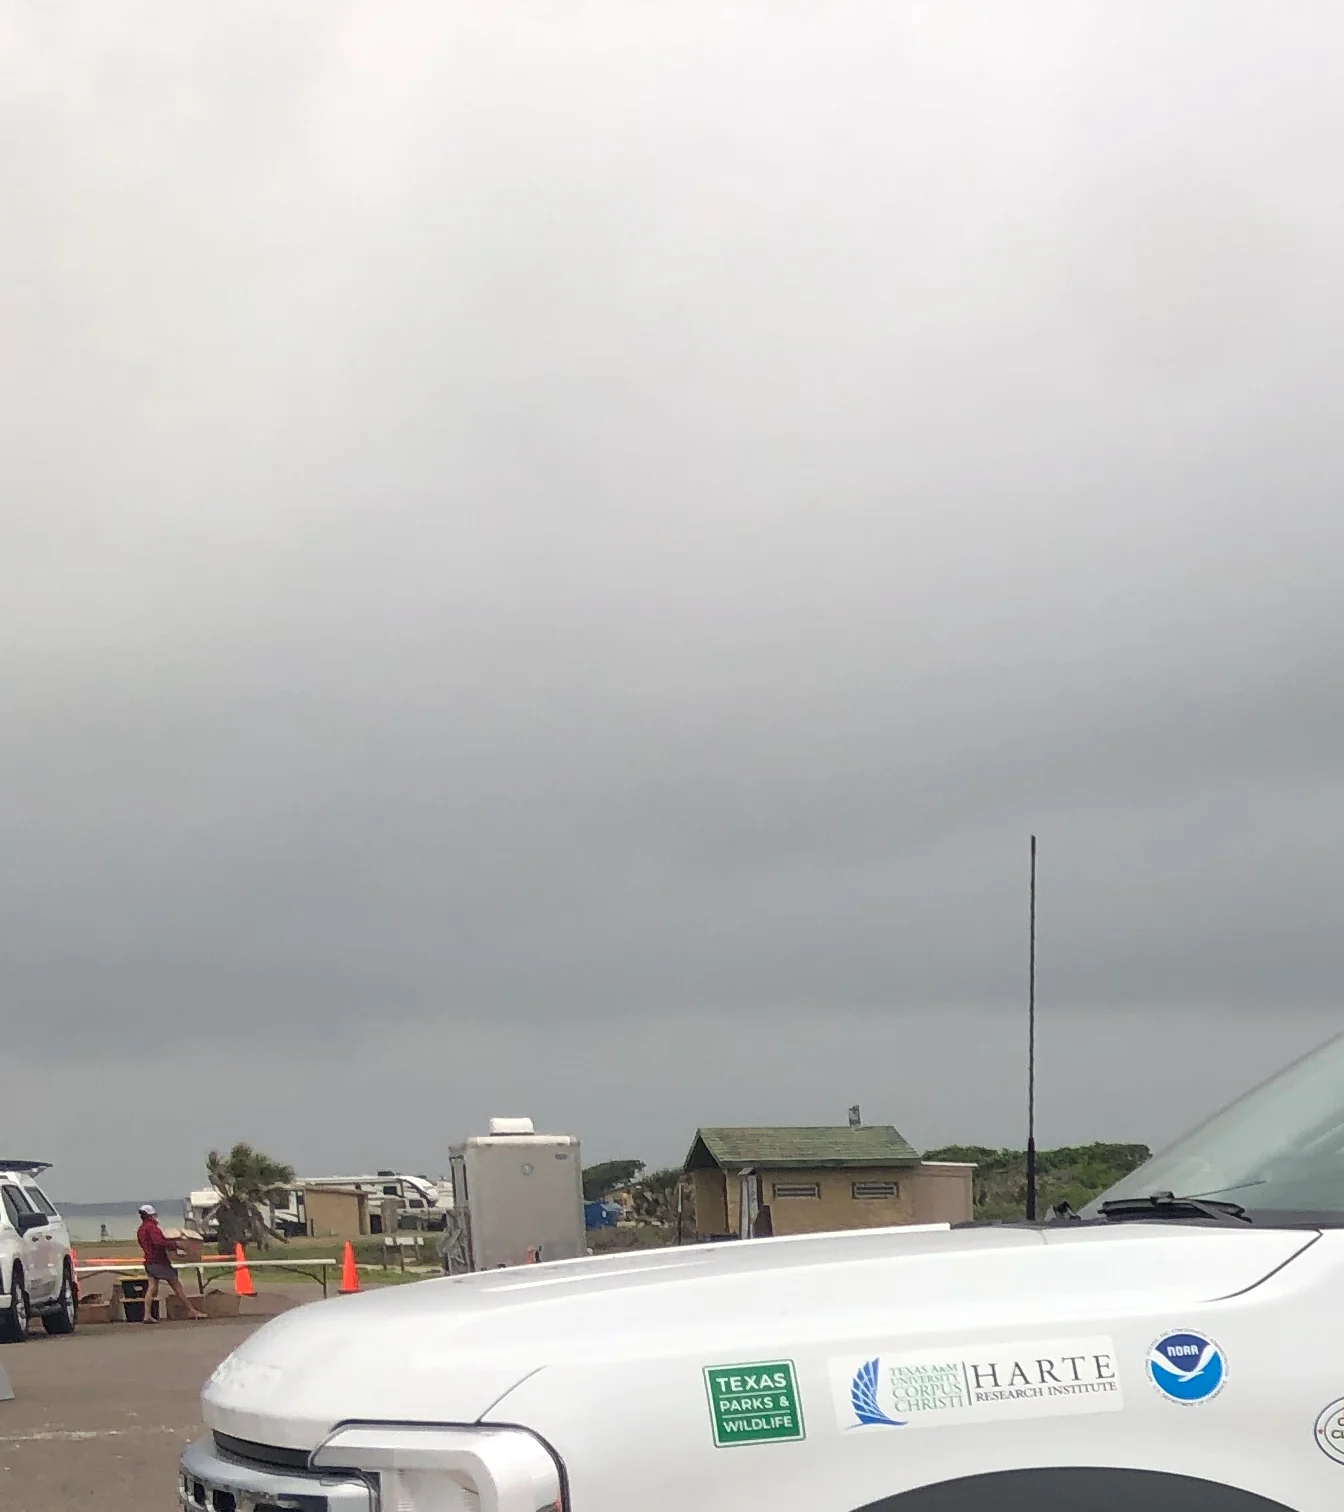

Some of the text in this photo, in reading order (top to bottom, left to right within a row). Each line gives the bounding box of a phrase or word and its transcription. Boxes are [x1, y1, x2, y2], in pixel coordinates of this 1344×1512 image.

[1166, 1345, 1199, 1357] NOAA
[889, 1365, 928, 1377] TEXAS
[890, 1373, 961, 1386] UNIVERSITY
[971, 1354, 1117, 1389] HARTE
[716, 1372, 787, 1392] TEXAS
[893, 1383, 963, 1399] CORPUS
[976, 1381, 1118, 1402] RESEARCH INSTITUTE
[719, 1395, 790, 1413] PARKS &
[895, 1395, 963, 1413] CHRISTI
[723, 1416, 794, 1433] WILDLIFE
